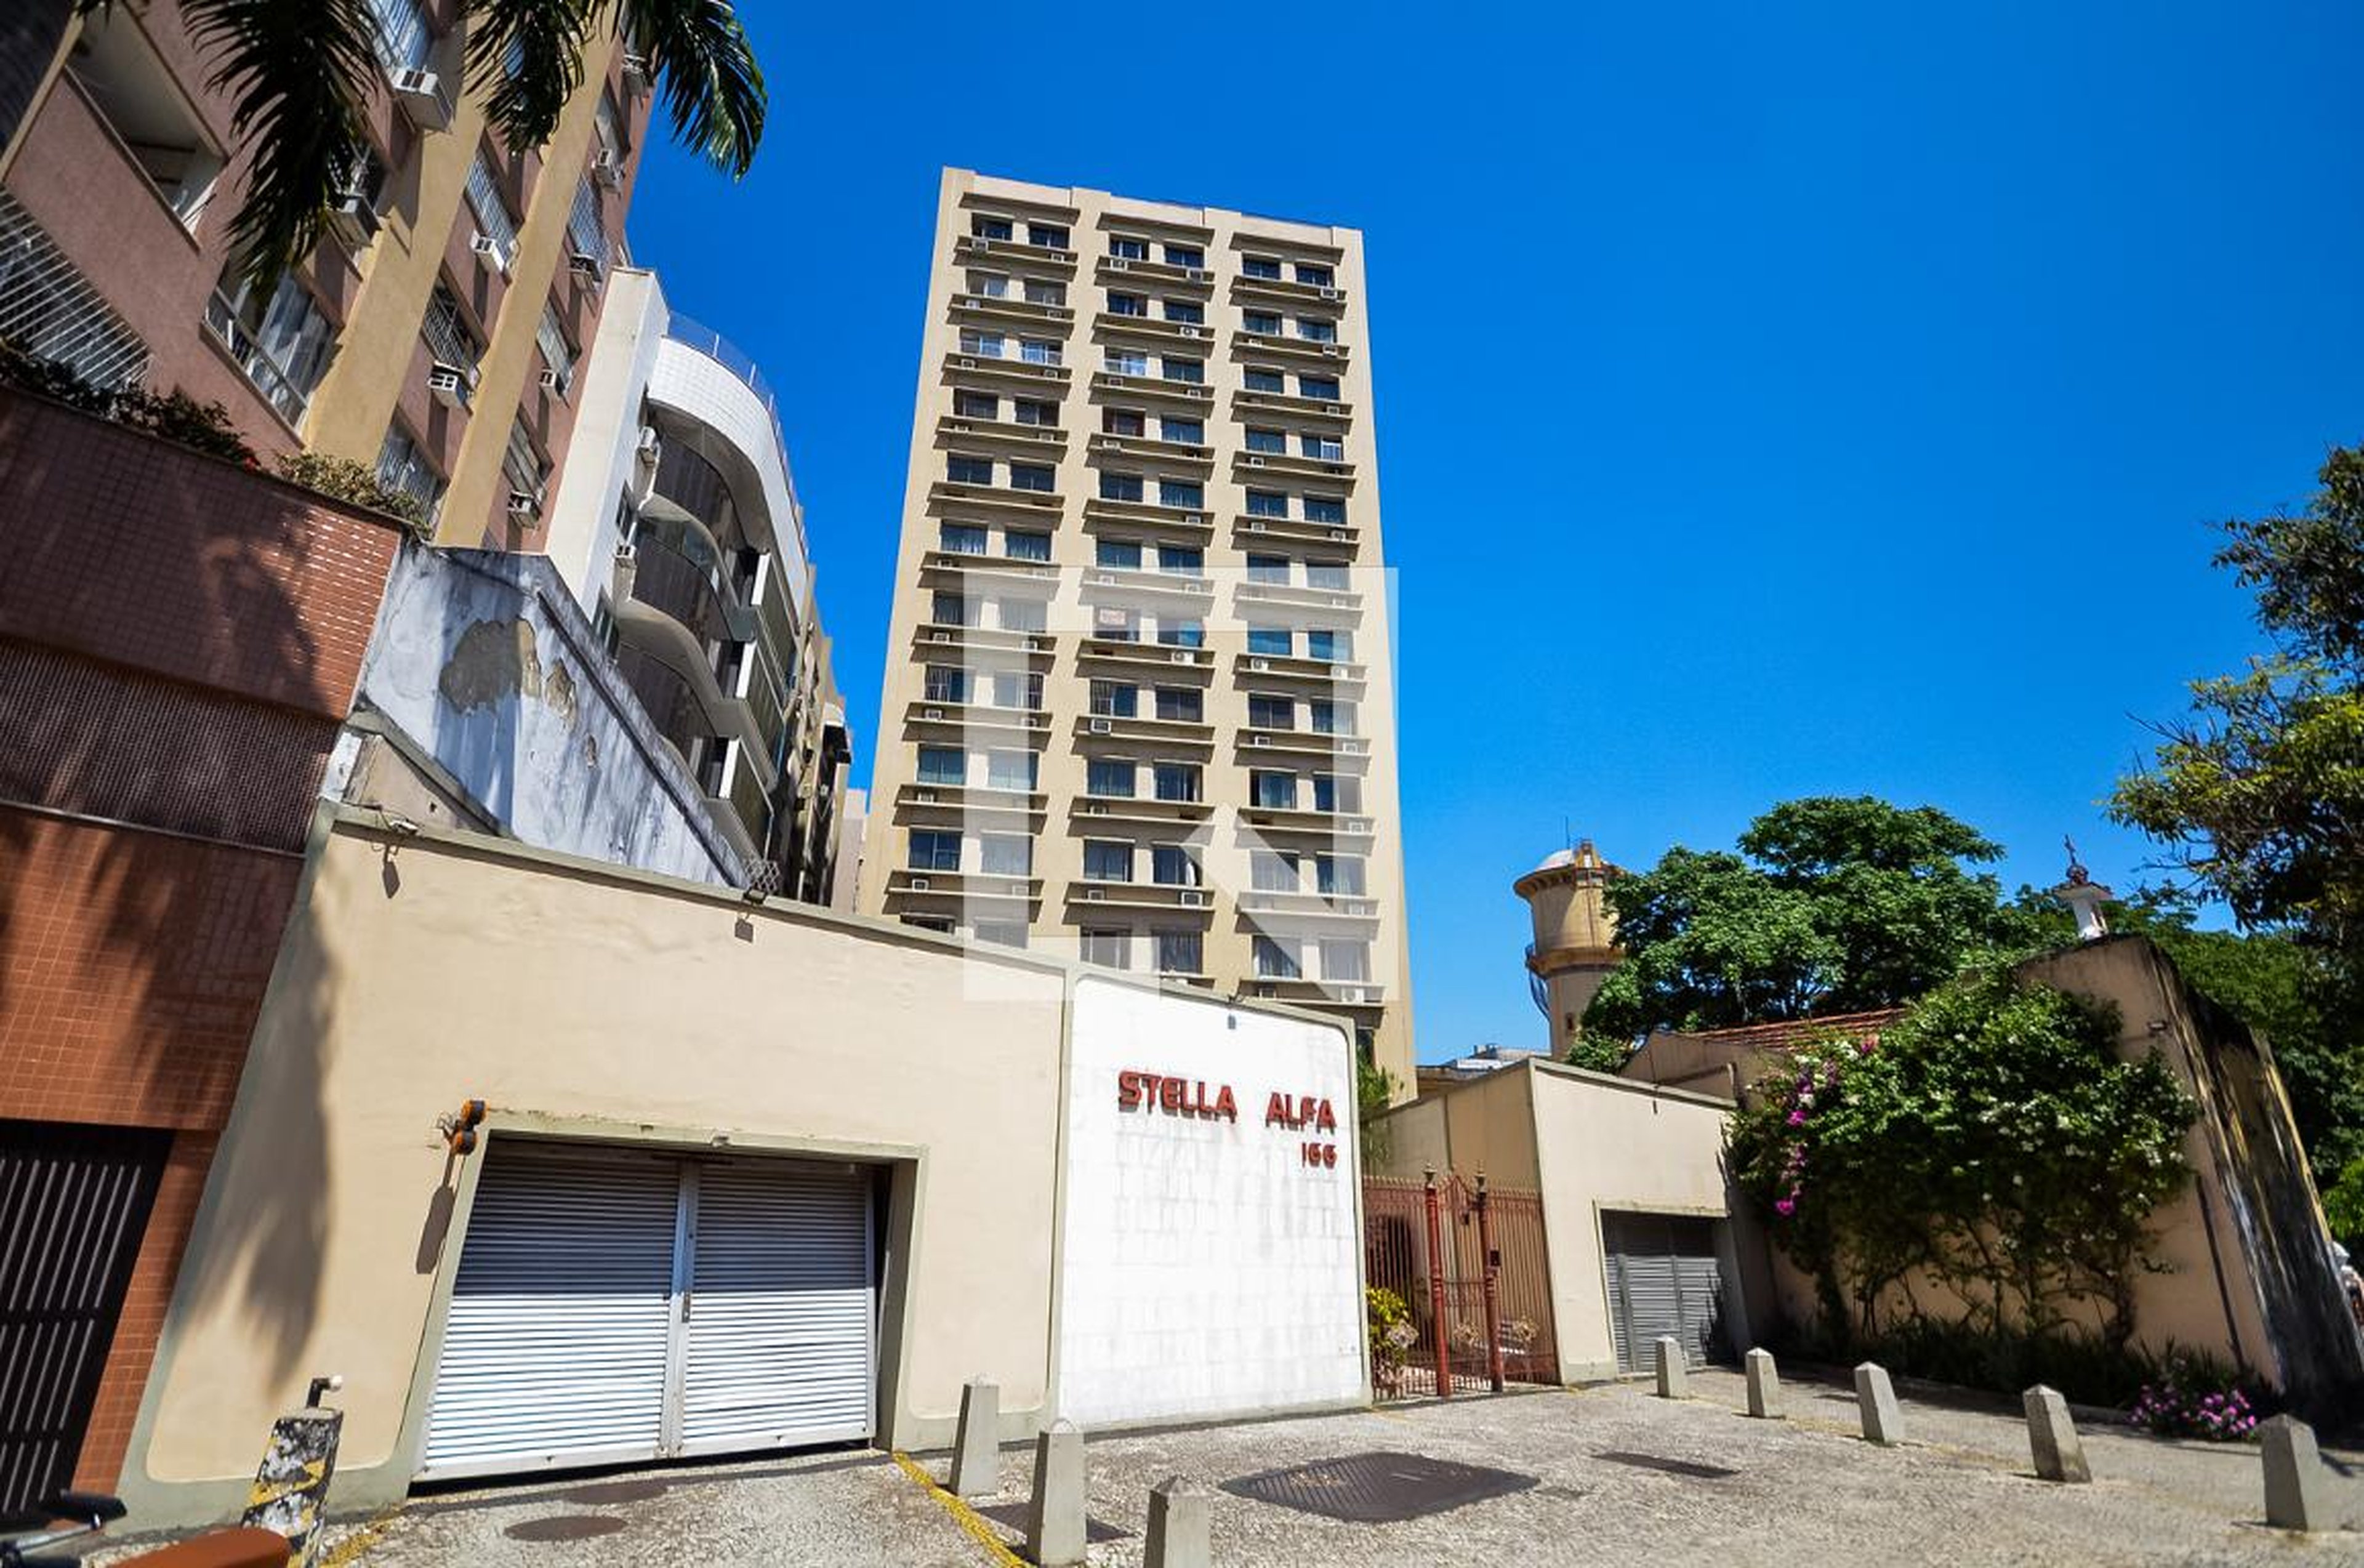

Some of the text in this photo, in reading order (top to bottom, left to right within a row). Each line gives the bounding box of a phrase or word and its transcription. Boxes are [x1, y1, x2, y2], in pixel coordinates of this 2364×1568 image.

[1119, 1071, 1337, 1132] STELLA ALFA
[1301, 1143, 1337, 1168] 166
